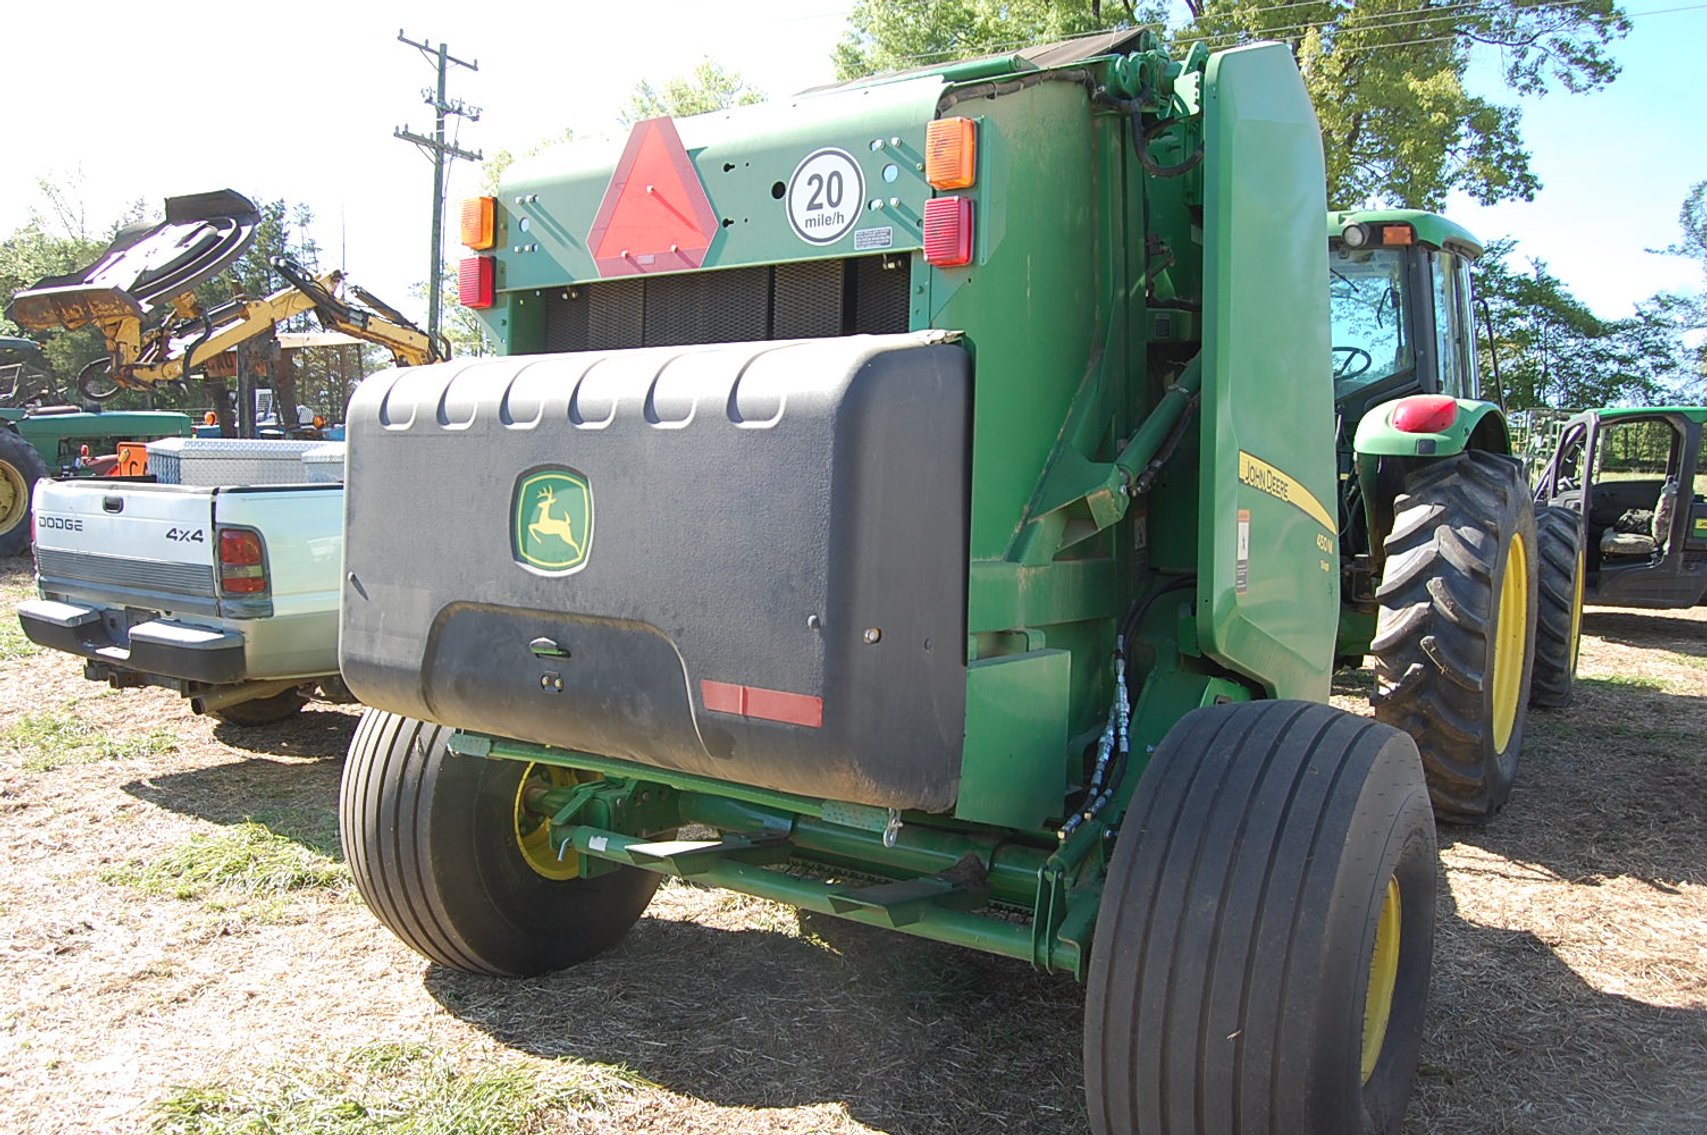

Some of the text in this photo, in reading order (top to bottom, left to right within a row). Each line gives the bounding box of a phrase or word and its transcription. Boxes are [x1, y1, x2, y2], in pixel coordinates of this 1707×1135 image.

[806, 170, 844, 211] 20
[805, 211, 845, 228] mile/h
[1245, 460, 1288, 498] JOHN DEERE
[39, 516, 83, 532] DODGE
